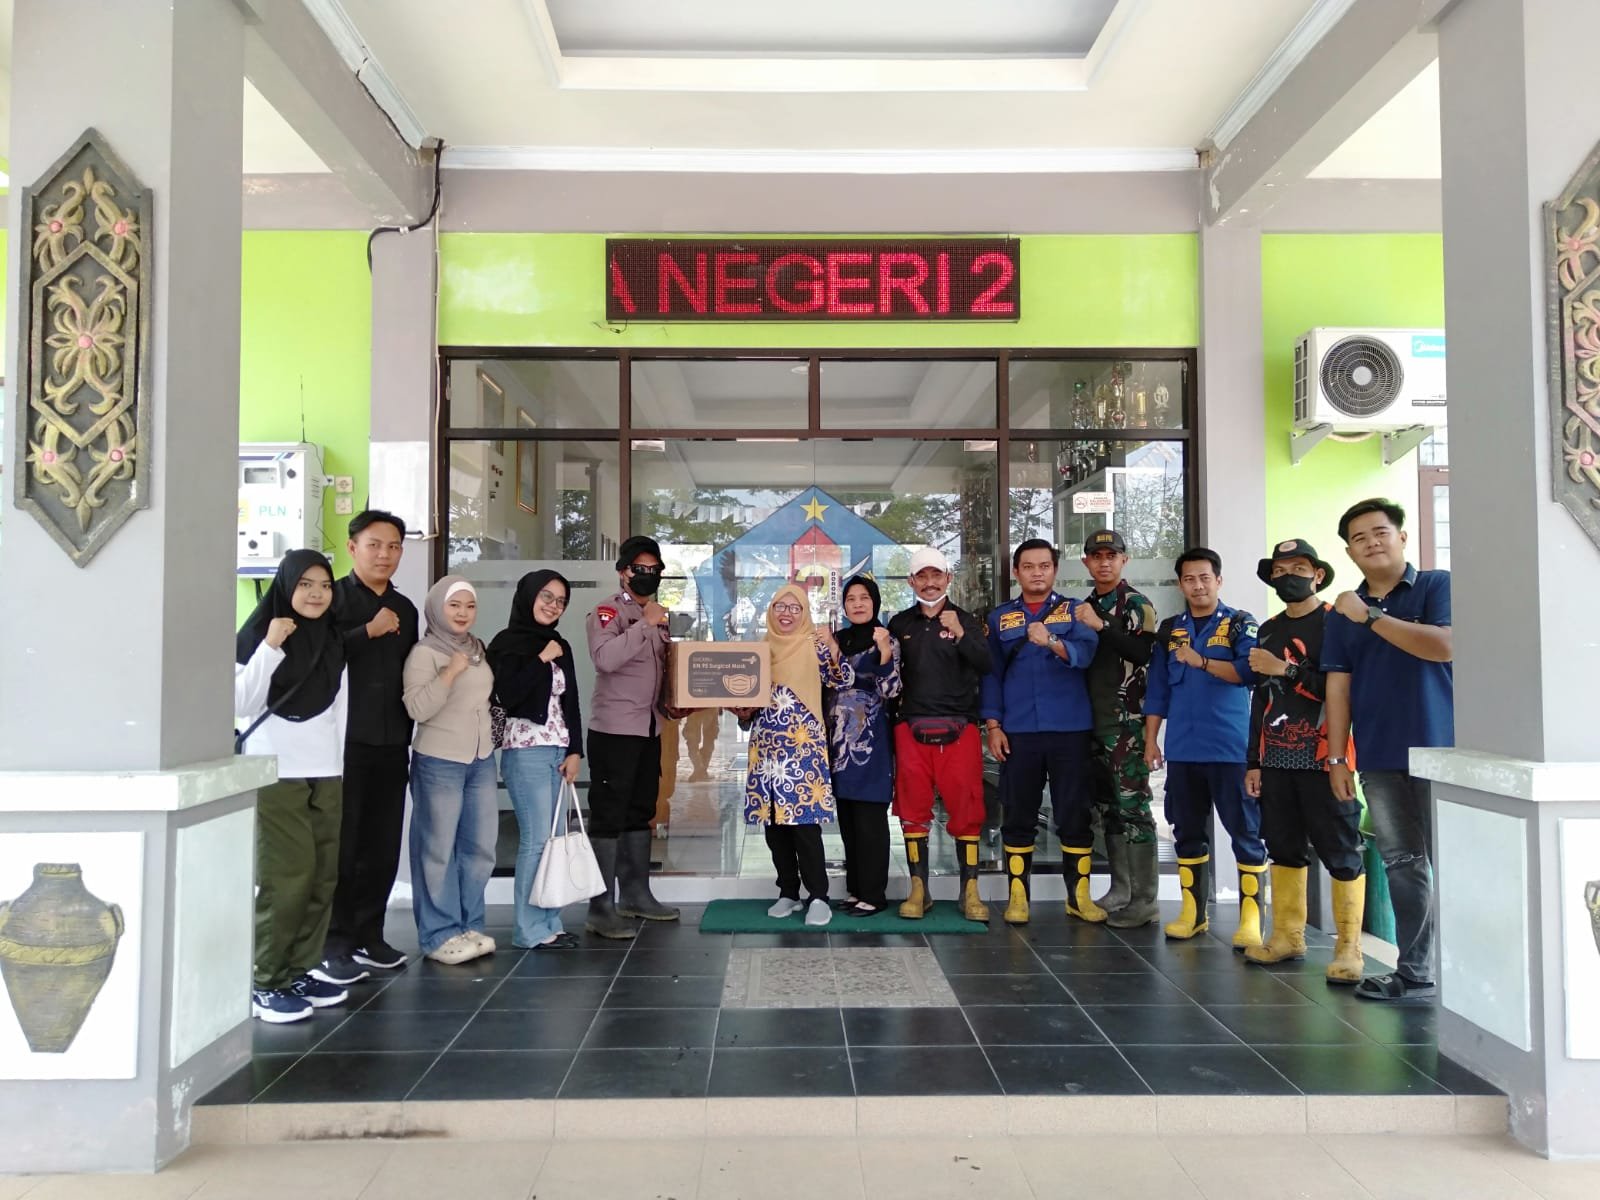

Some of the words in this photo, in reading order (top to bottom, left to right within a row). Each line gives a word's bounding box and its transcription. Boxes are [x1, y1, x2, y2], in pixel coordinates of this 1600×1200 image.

[657, 251, 950, 314] NEGERI
[969, 251, 1016, 313] 2
[259, 505, 286, 517] PLN
